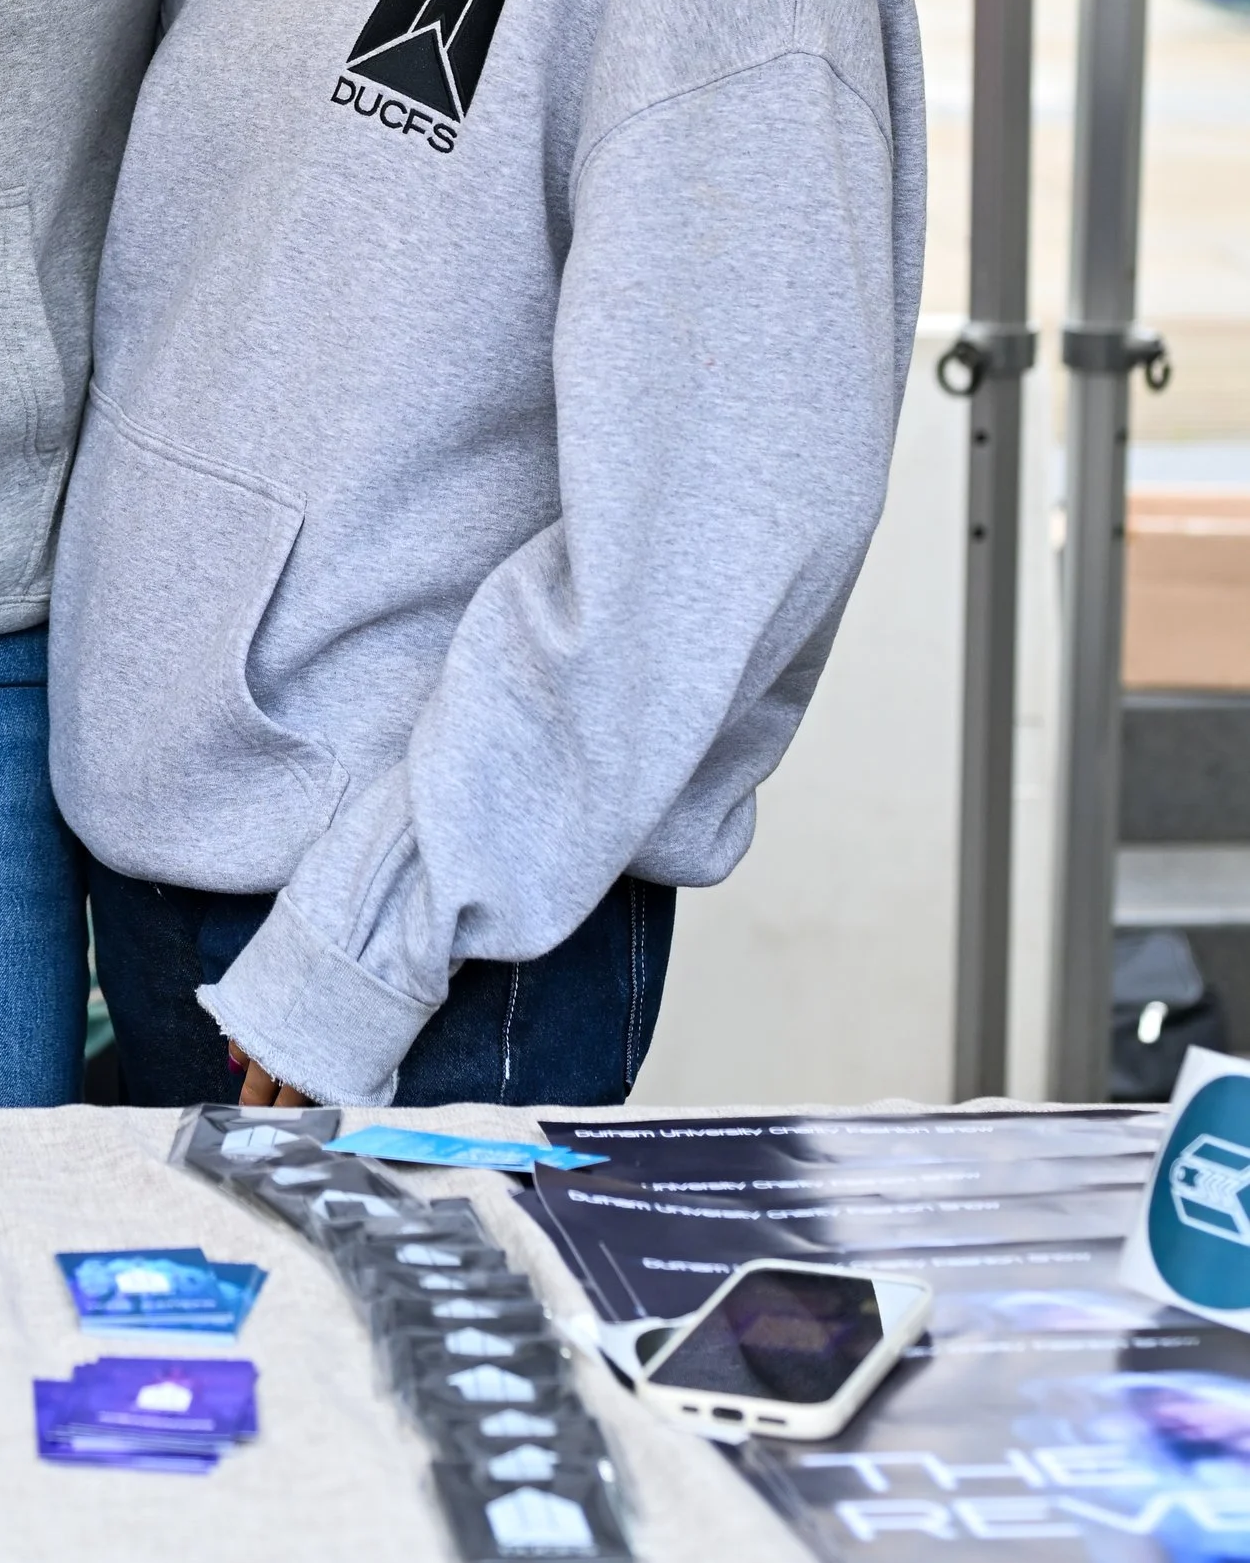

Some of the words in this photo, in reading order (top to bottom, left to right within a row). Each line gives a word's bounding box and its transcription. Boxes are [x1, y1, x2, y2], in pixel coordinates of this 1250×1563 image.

[330, 75, 458, 154] DUCFS
[574, 1129, 655, 1138] Durham
[659, 1127, 763, 1137] University
[769, 1126, 839, 1135] Charity
[800, 1443, 1156, 1493] THE
